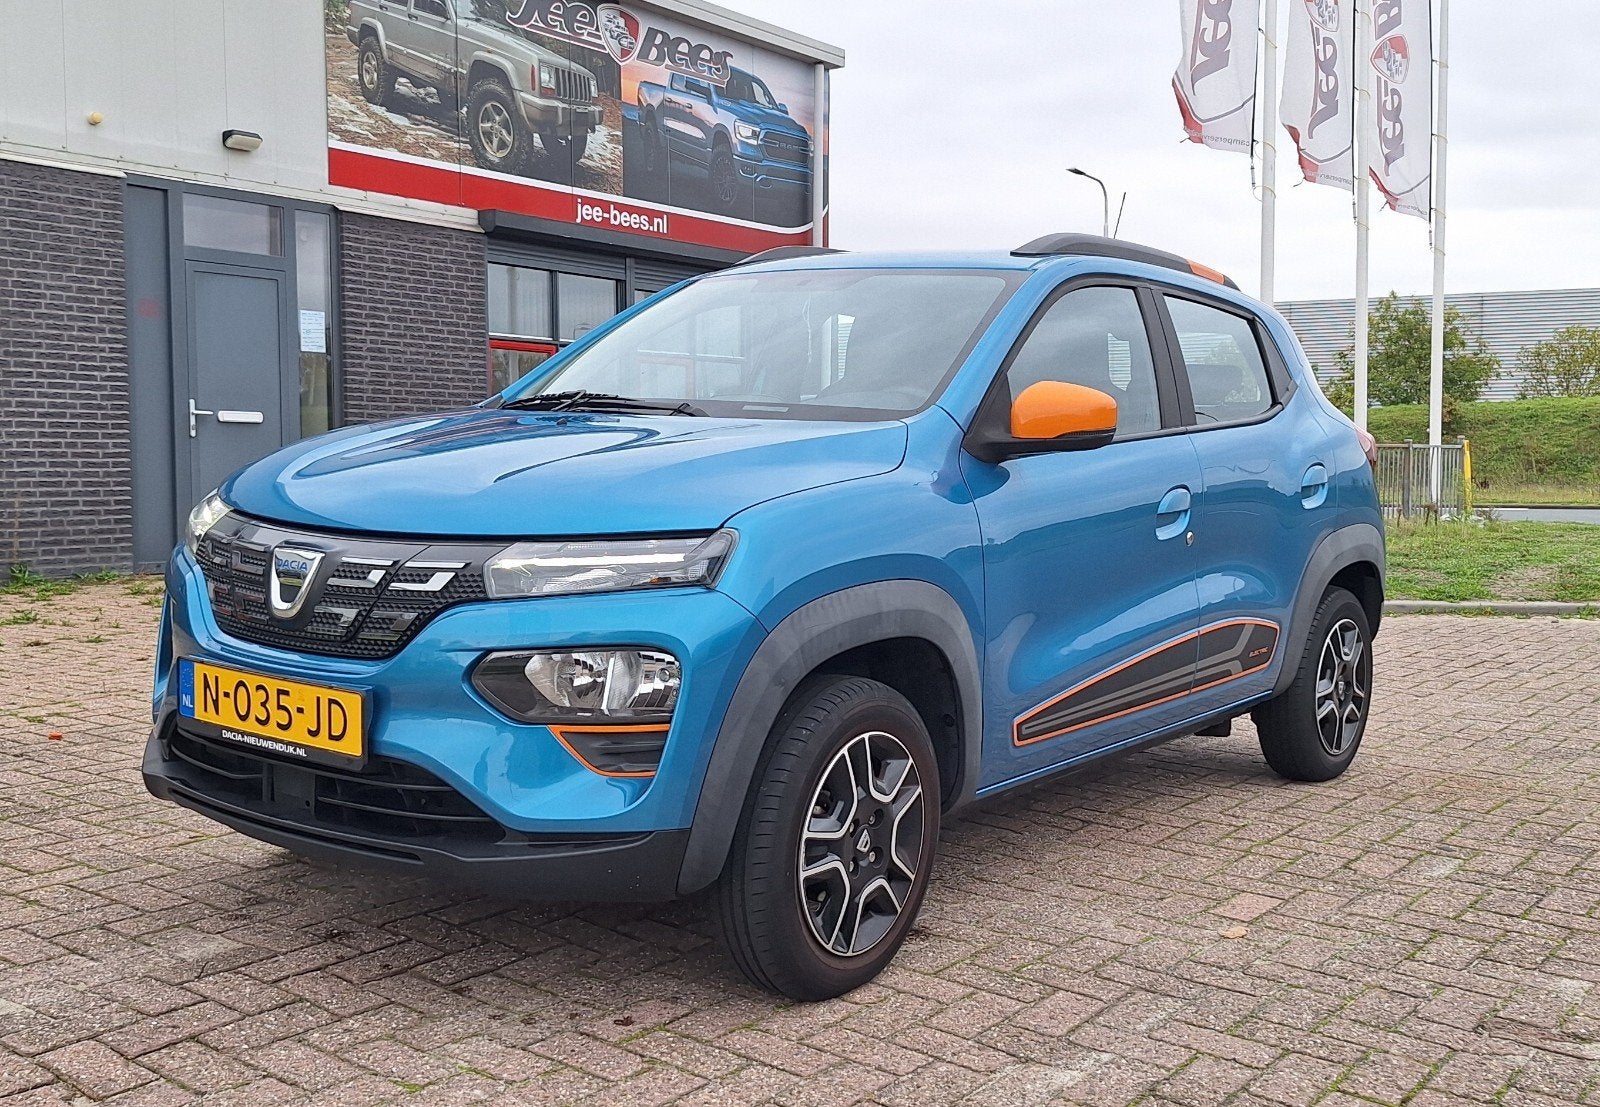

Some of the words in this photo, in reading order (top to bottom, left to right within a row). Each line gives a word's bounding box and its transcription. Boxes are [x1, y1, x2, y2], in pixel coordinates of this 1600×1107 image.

[506, 0, 599, 37] Jee
[636, 26, 734, 82] Bees
[576, 198, 668, 234] jee-bees.nl
[276, 559, 309, 572] DACIA
[182, 694, 194, 708] NL
[202, 671, 349, 742] N-035-JD
